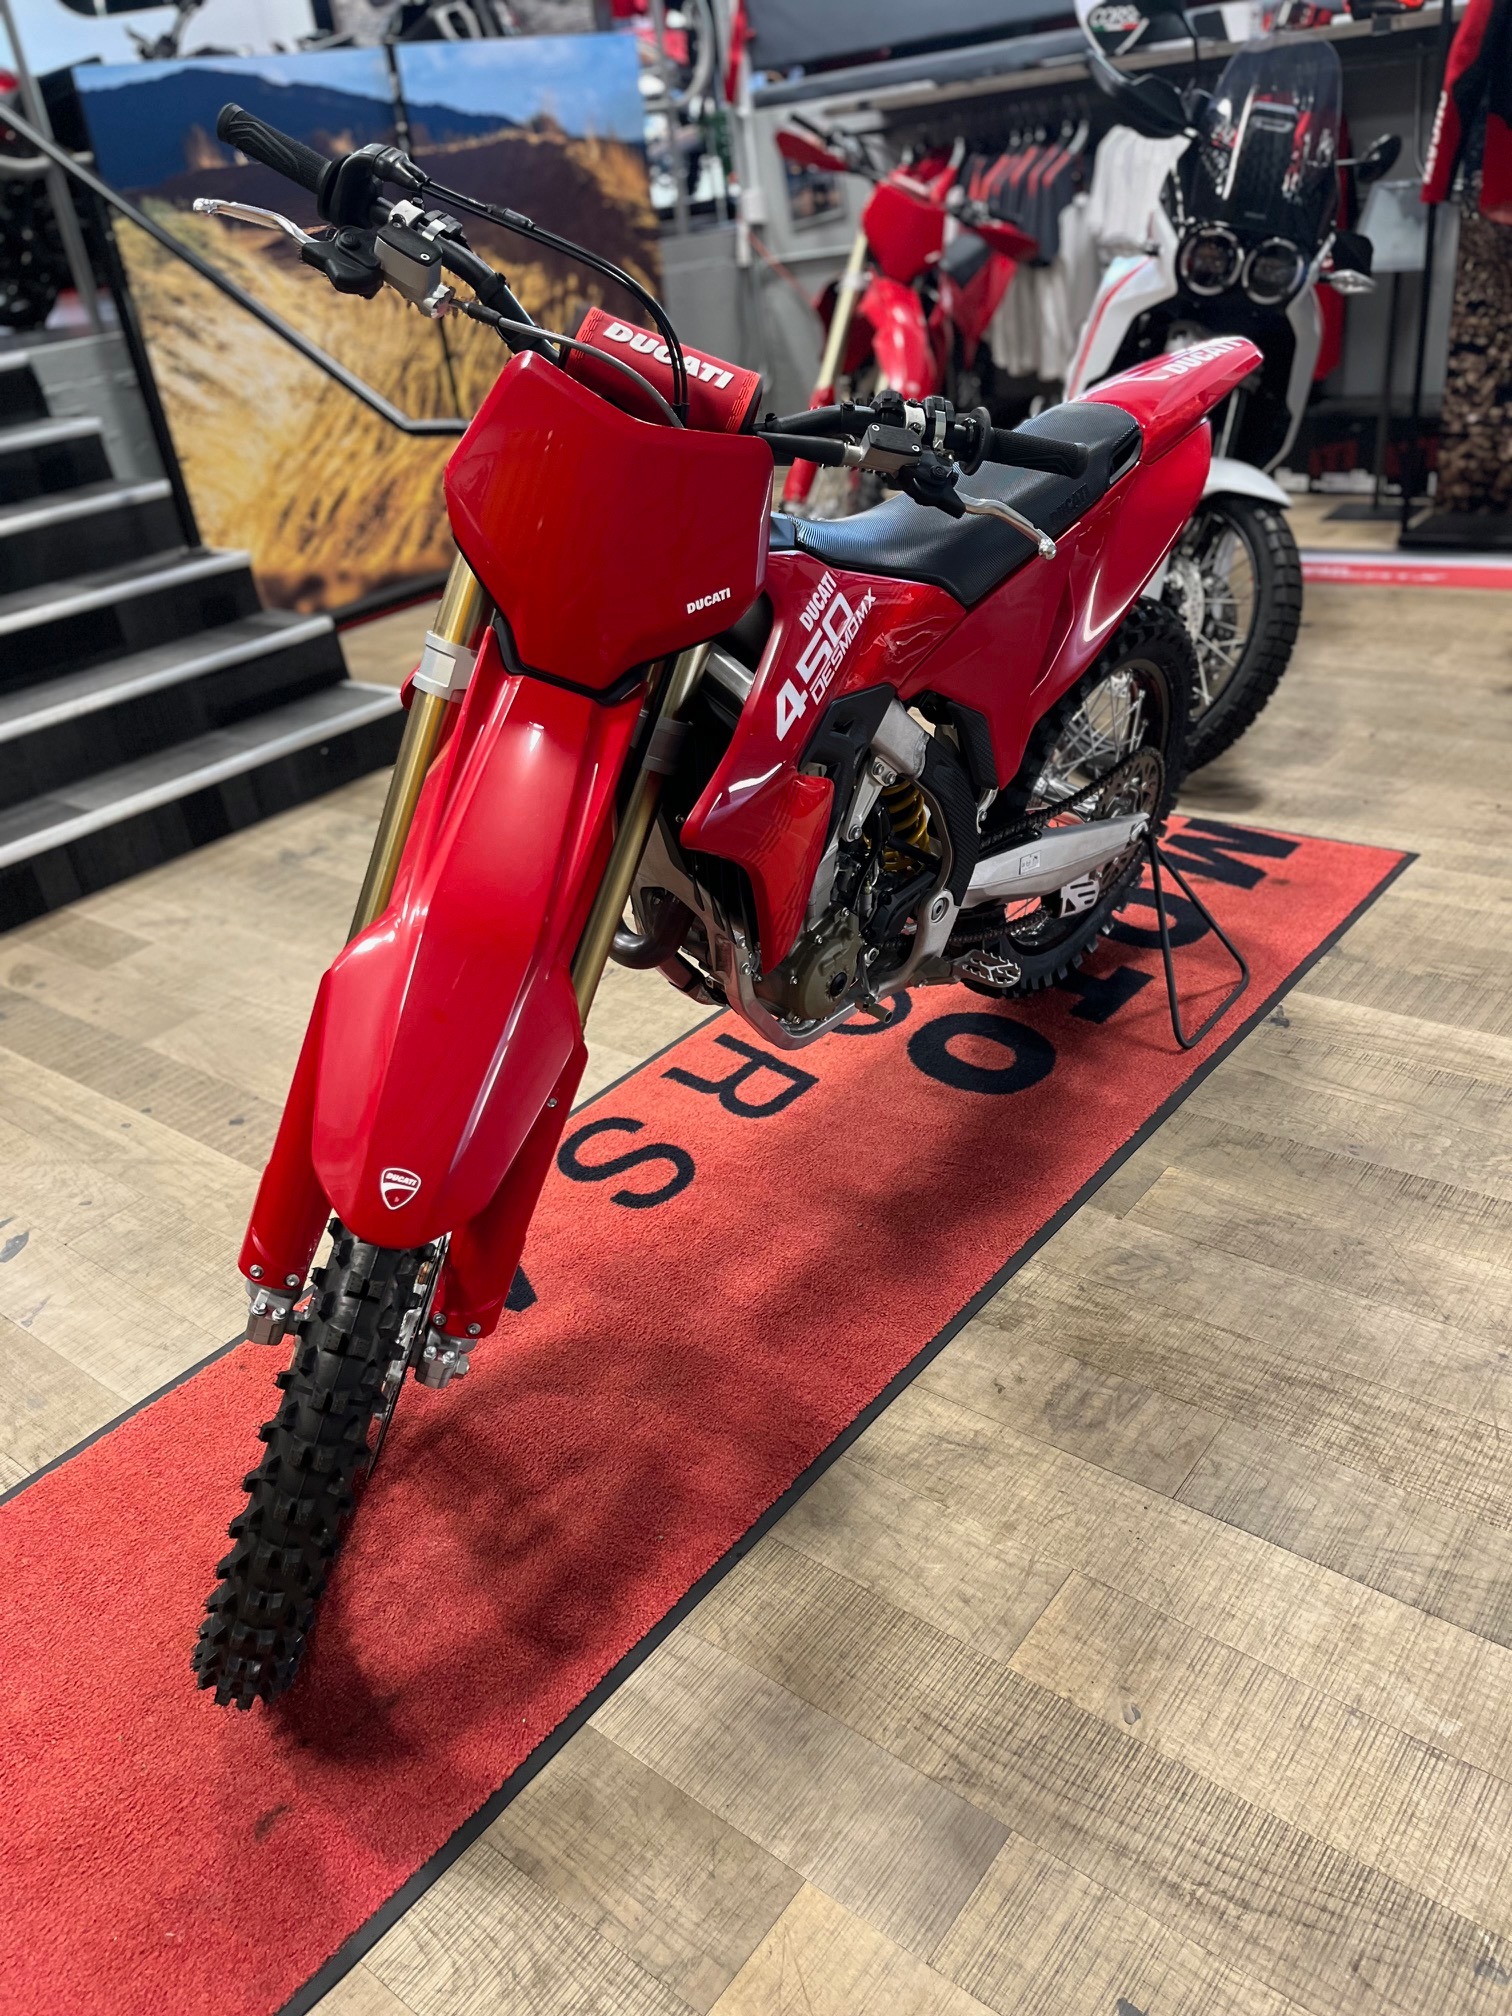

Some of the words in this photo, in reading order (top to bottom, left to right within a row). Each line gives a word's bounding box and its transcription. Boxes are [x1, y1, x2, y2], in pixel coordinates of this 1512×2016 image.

[603, 321, 735, 390] DUCATI
[1166, 339, 1244, 374] DUCATI
[686, 587, 731, 615] DUCATI
[799, 570, 837, 632] DUCATI
[776, 592, 854, 742] 450
[385, 1172, 418, 1187] DUCATI
